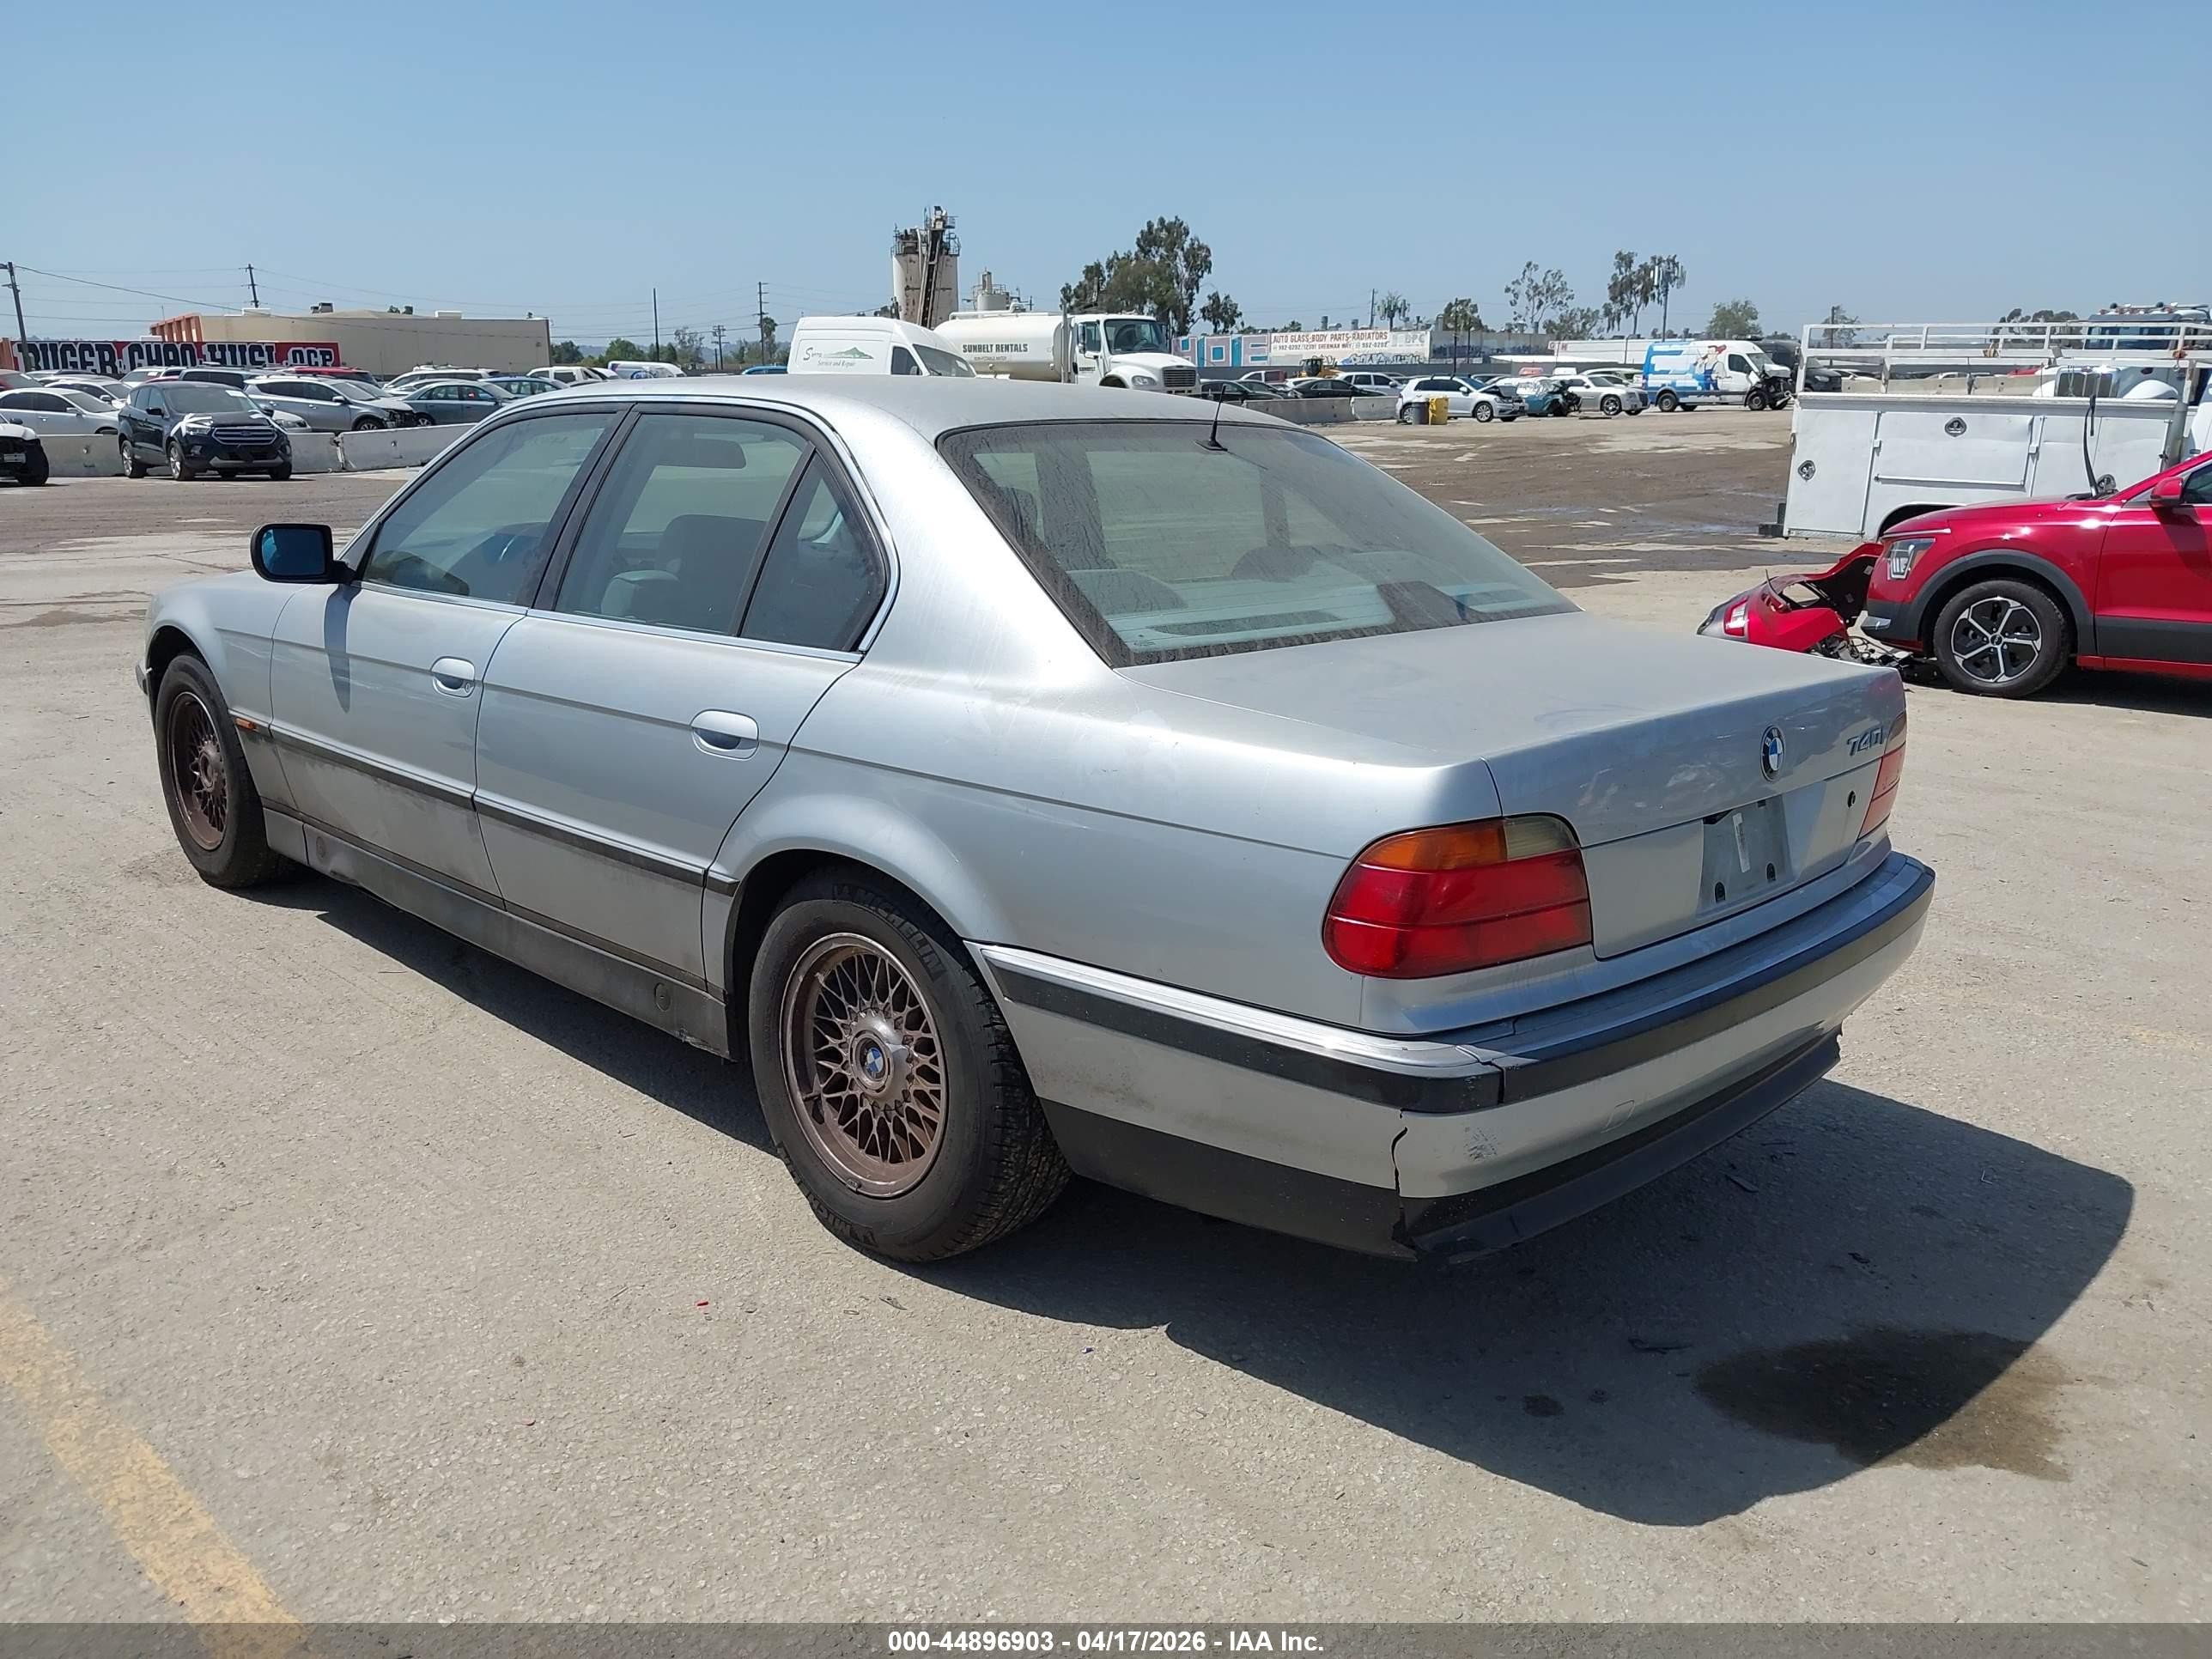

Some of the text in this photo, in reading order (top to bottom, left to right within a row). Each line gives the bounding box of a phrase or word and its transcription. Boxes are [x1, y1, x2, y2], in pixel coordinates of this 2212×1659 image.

[1273, 335, 1289, 343] AUTO
[963, 343, 1029, 353] SUNBELT RENTALS
